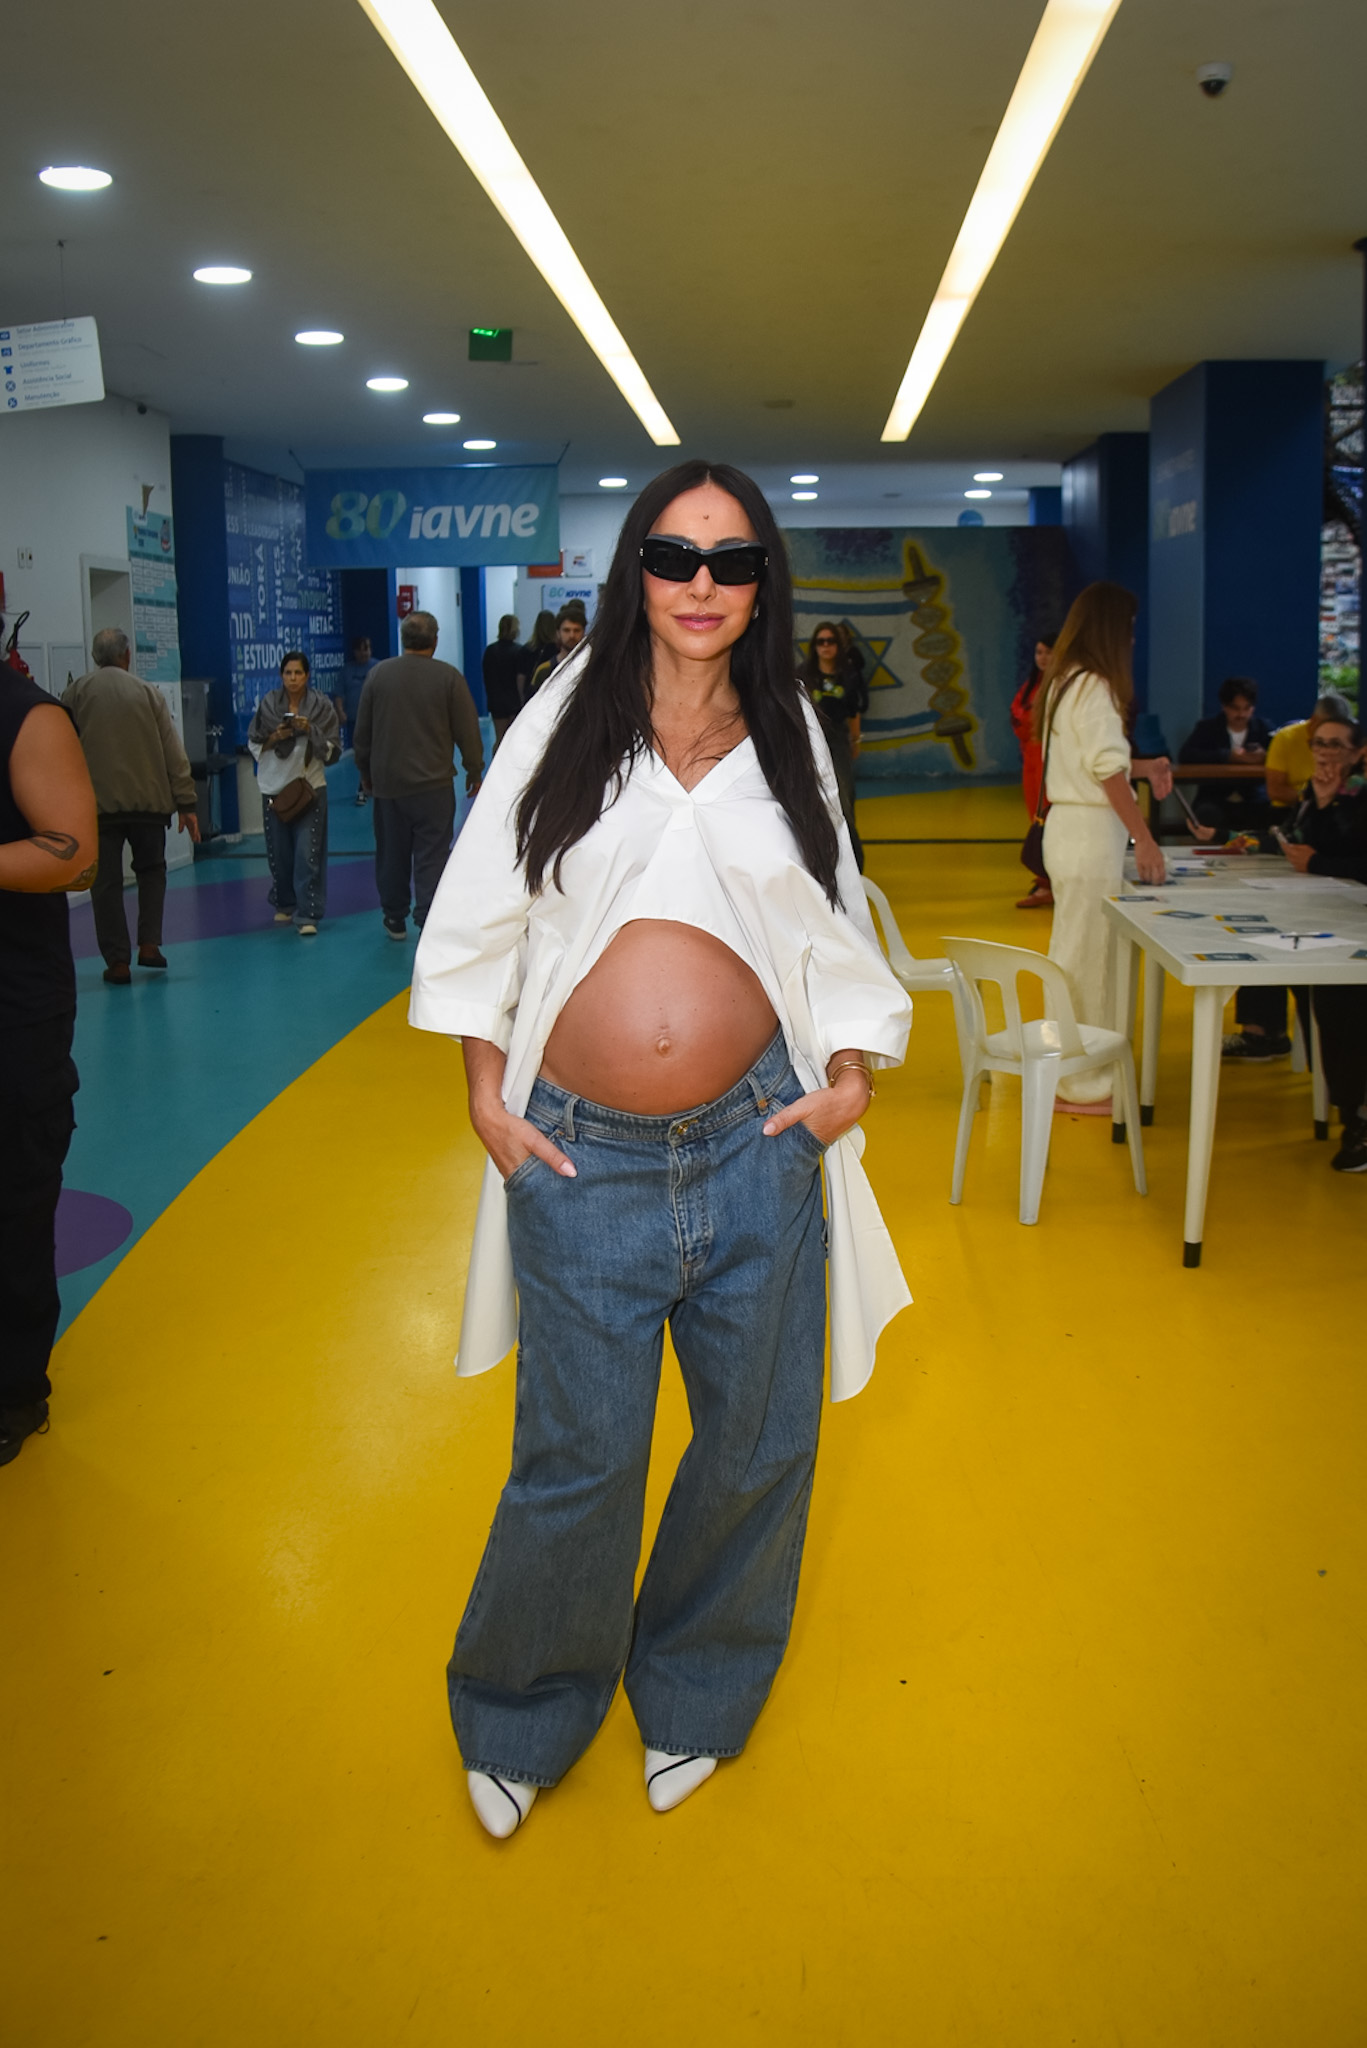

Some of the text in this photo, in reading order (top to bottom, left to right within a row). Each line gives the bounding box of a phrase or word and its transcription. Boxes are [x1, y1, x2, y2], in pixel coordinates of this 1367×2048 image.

[325, 490, 406, 540] 80
[409, 503, 540, 540] iavne
[229, 611, 253, 640] תור
